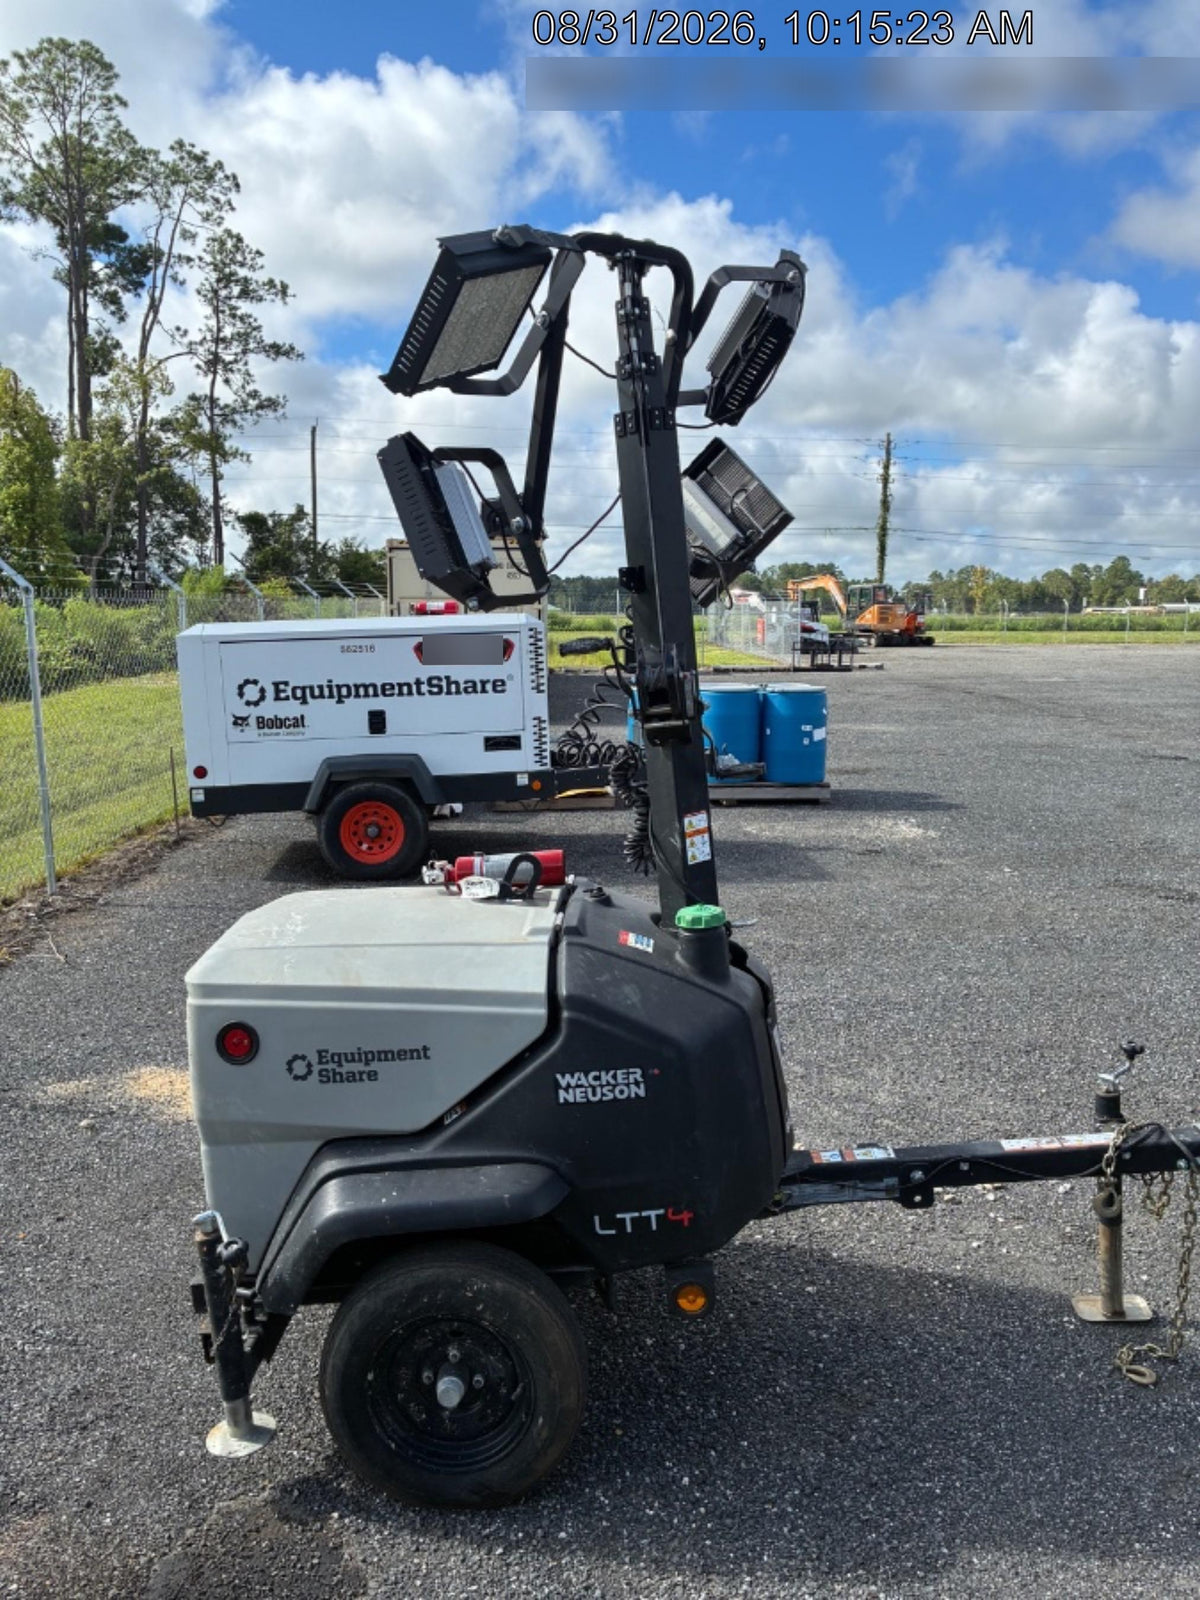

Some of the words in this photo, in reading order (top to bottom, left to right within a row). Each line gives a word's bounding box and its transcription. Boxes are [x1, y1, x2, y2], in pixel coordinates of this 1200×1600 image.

[271, 675, 507, 705] EquipmentShare
[256, 714, 306, 730] Bobcat
[316, 1045, 431, 1067] Equipment
[317, 1068, 379, 1084] Share
[555, 1067, 644, 1088] WACKER
[558, 1083, 646, 1104] NEUSON
[593, 1207, 694, 1235] LTT4
